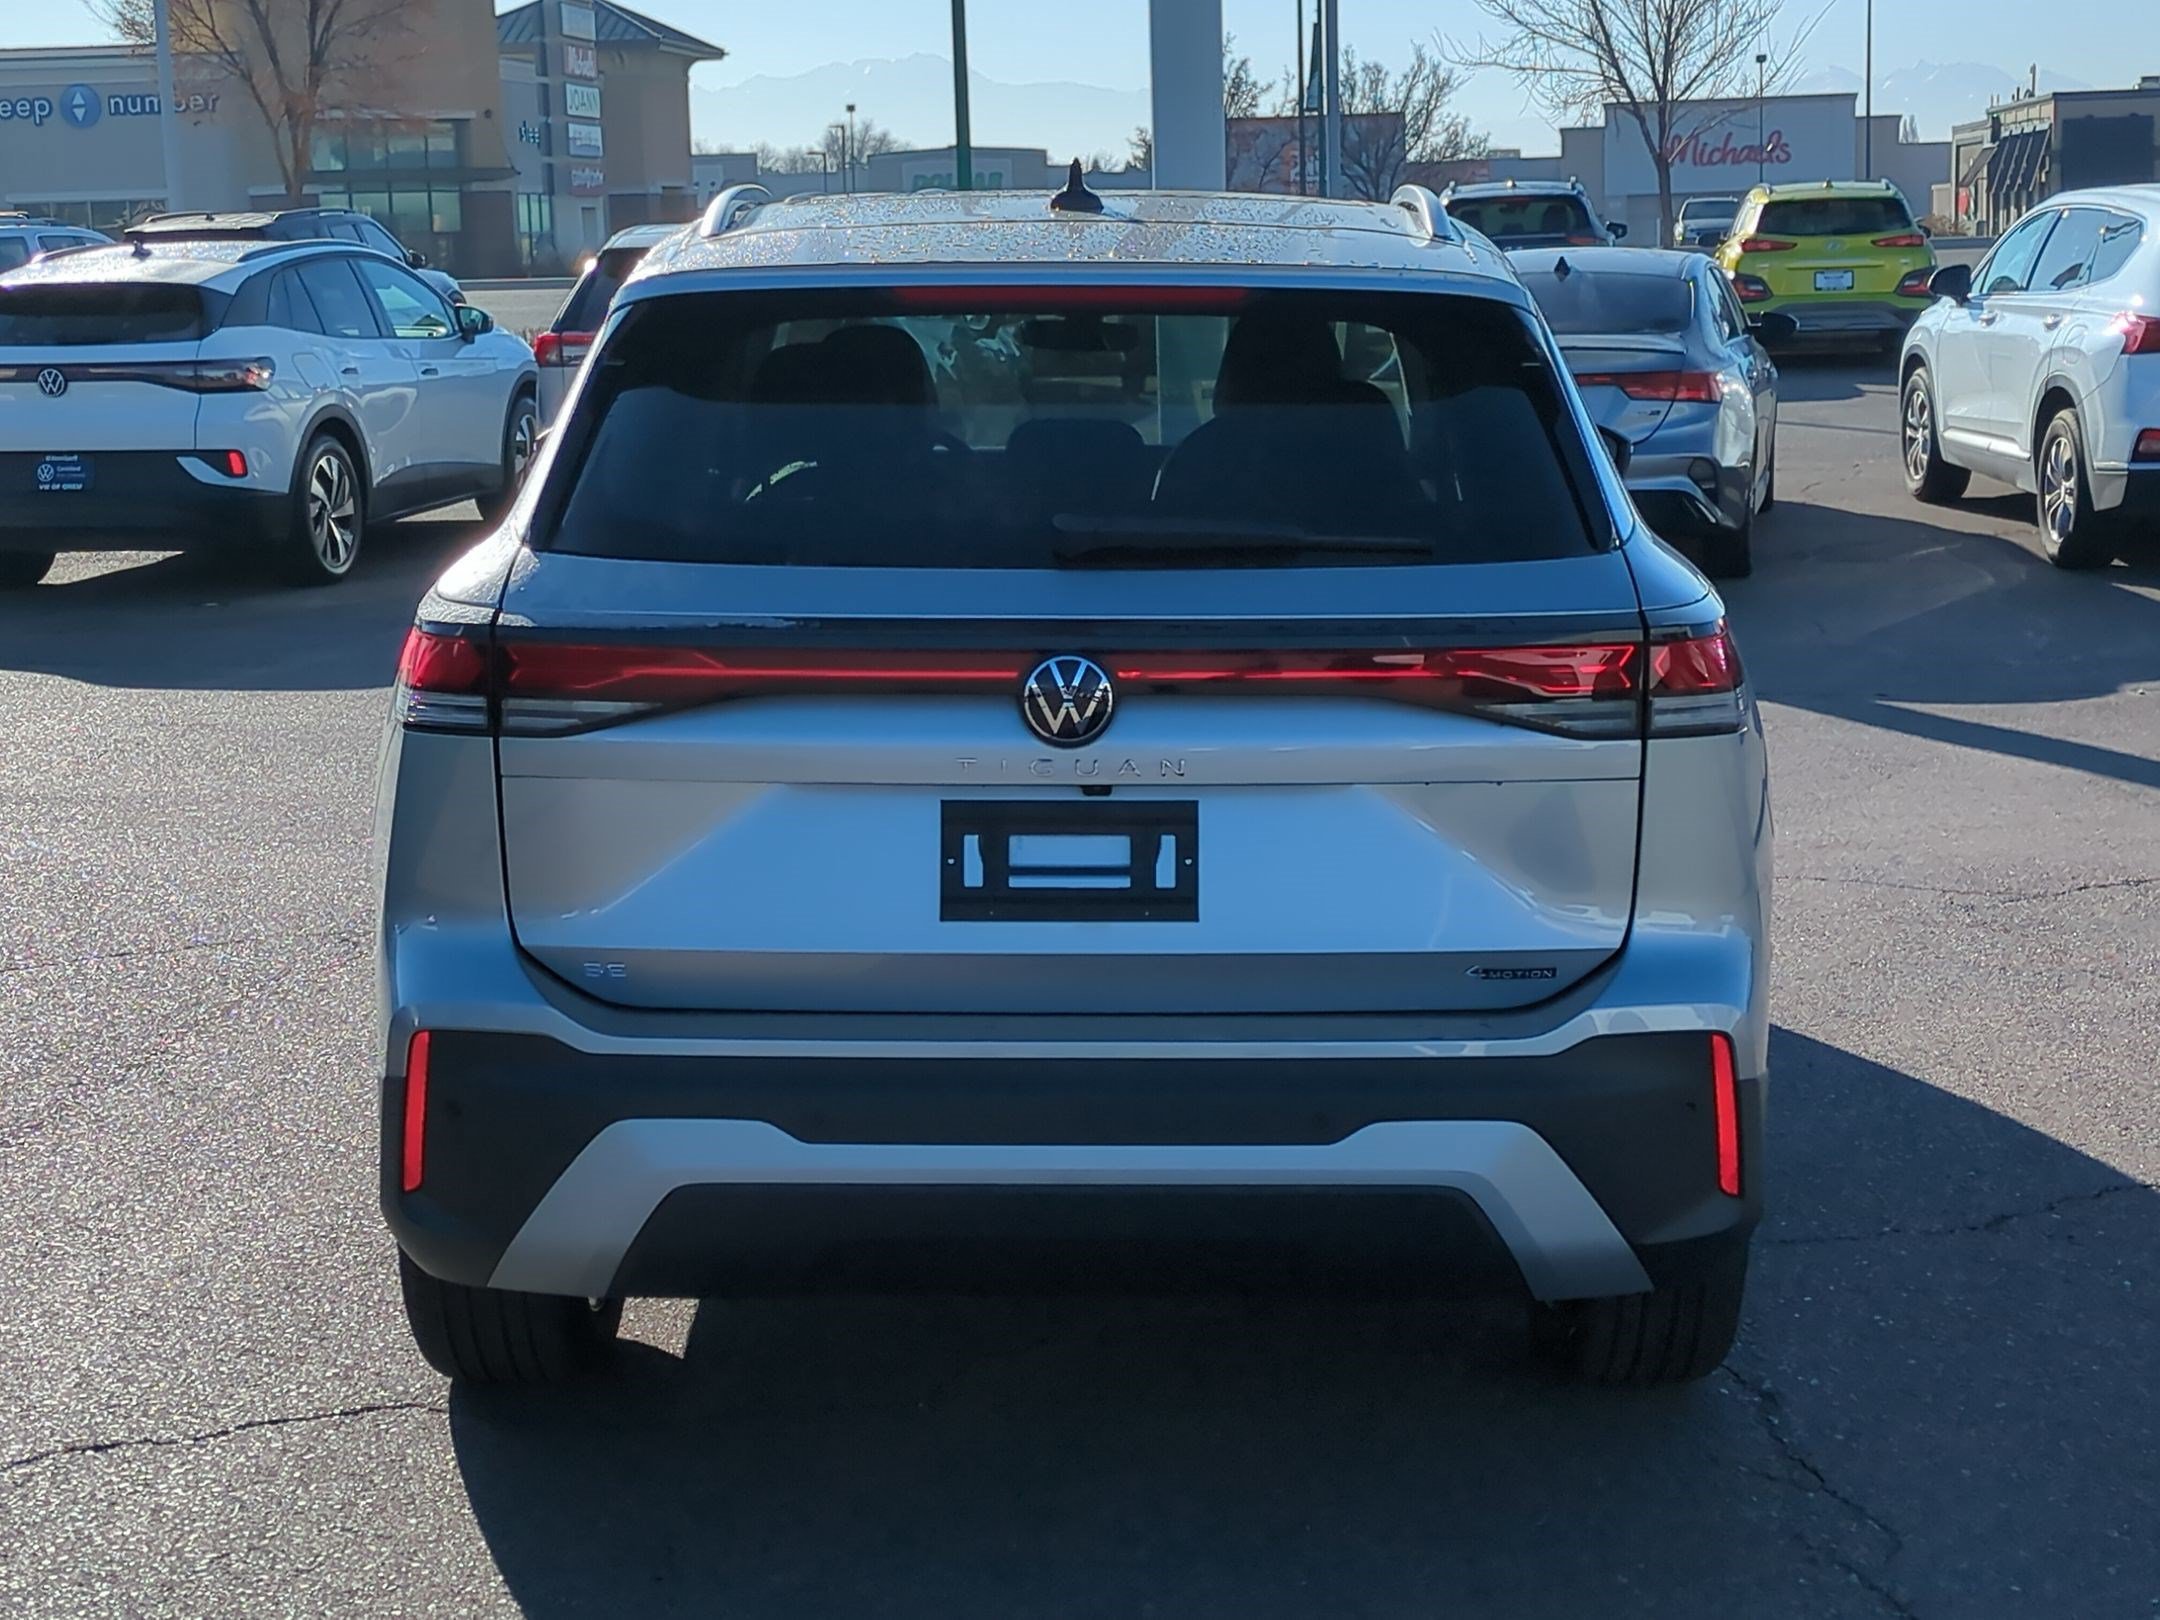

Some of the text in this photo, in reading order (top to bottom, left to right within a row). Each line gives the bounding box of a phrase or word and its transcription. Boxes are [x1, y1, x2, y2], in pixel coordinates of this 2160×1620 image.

[569, 87, 599, 112] JOANN
[1666, 129, 1792, 166] Michaels
[956, 758, 1187, 777] TIGUAN
